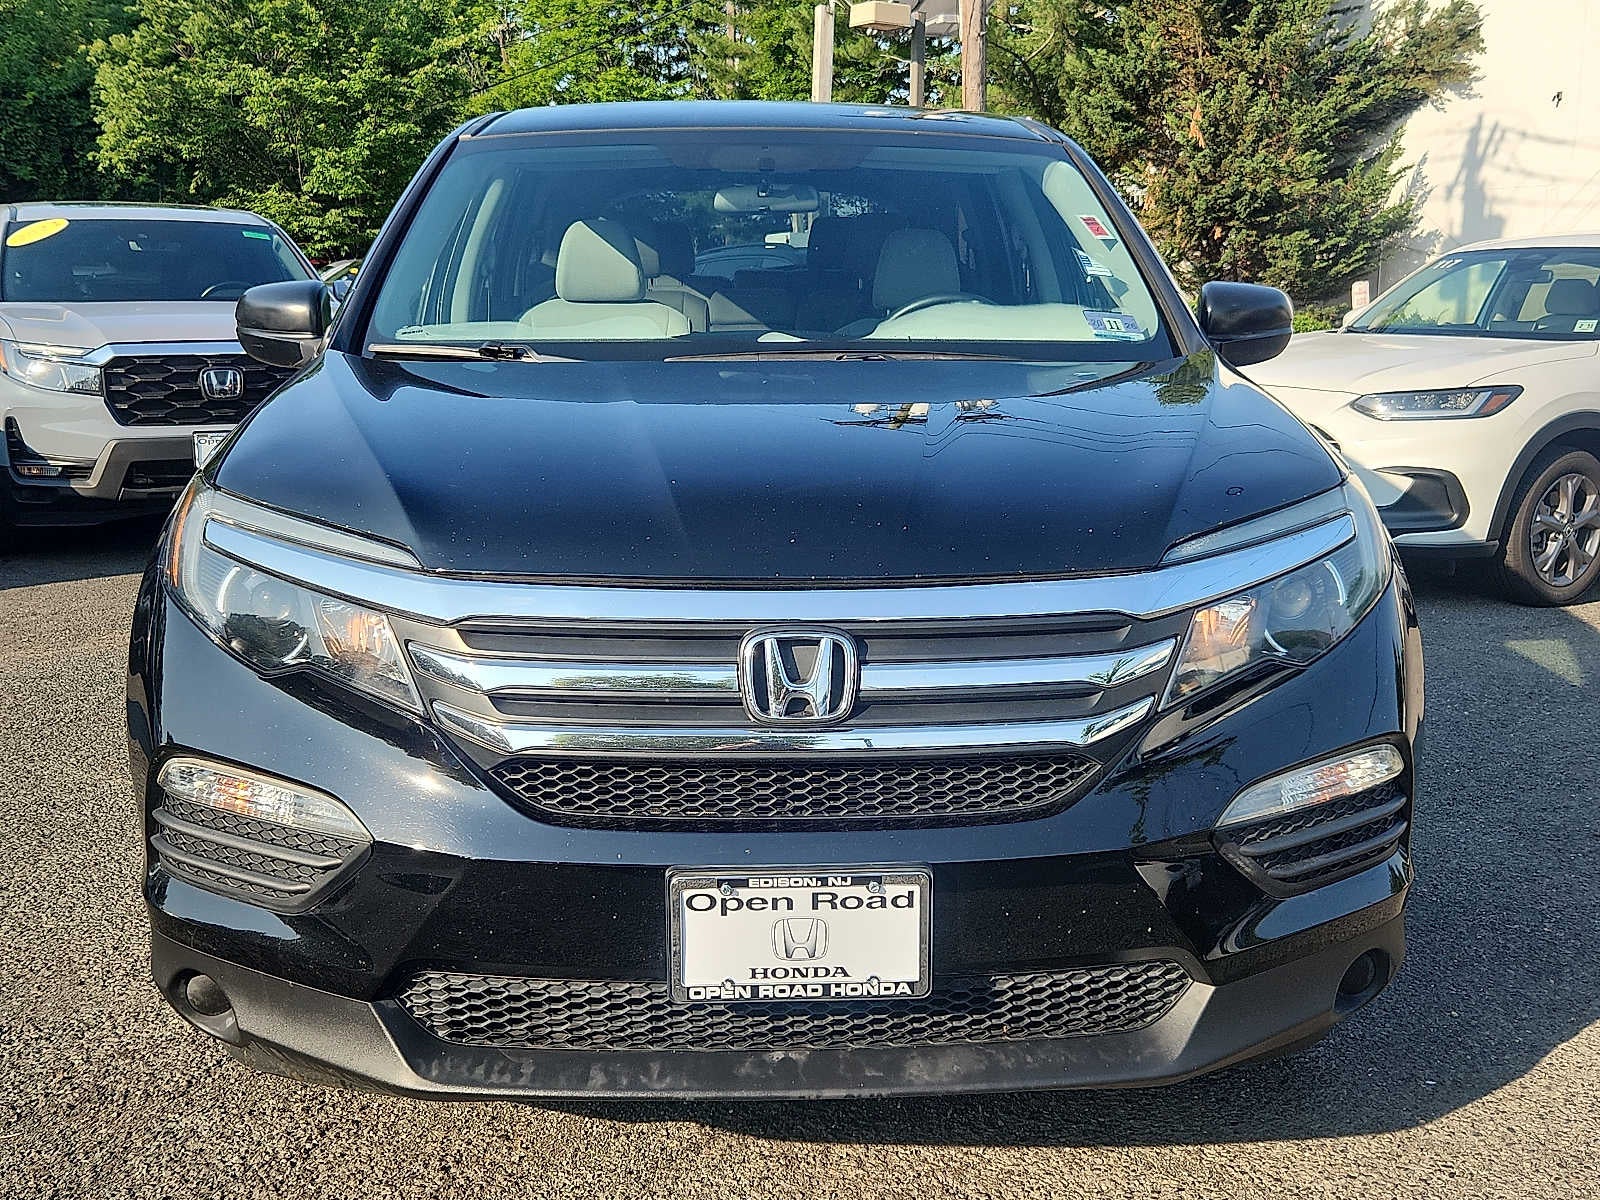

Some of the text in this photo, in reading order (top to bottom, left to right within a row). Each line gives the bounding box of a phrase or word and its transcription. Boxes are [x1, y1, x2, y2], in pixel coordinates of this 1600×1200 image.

[1106, 319, 1121, 331] 11
[198, 438, 221, 446] Ope
[748, 876, 852, 888] EDISON, NJ
[685, 890, 915, 917] Open Road
[748, 966, 852, 980] HONDA
[688, 982, 913, 1000] OPEN ROAD HONDA
